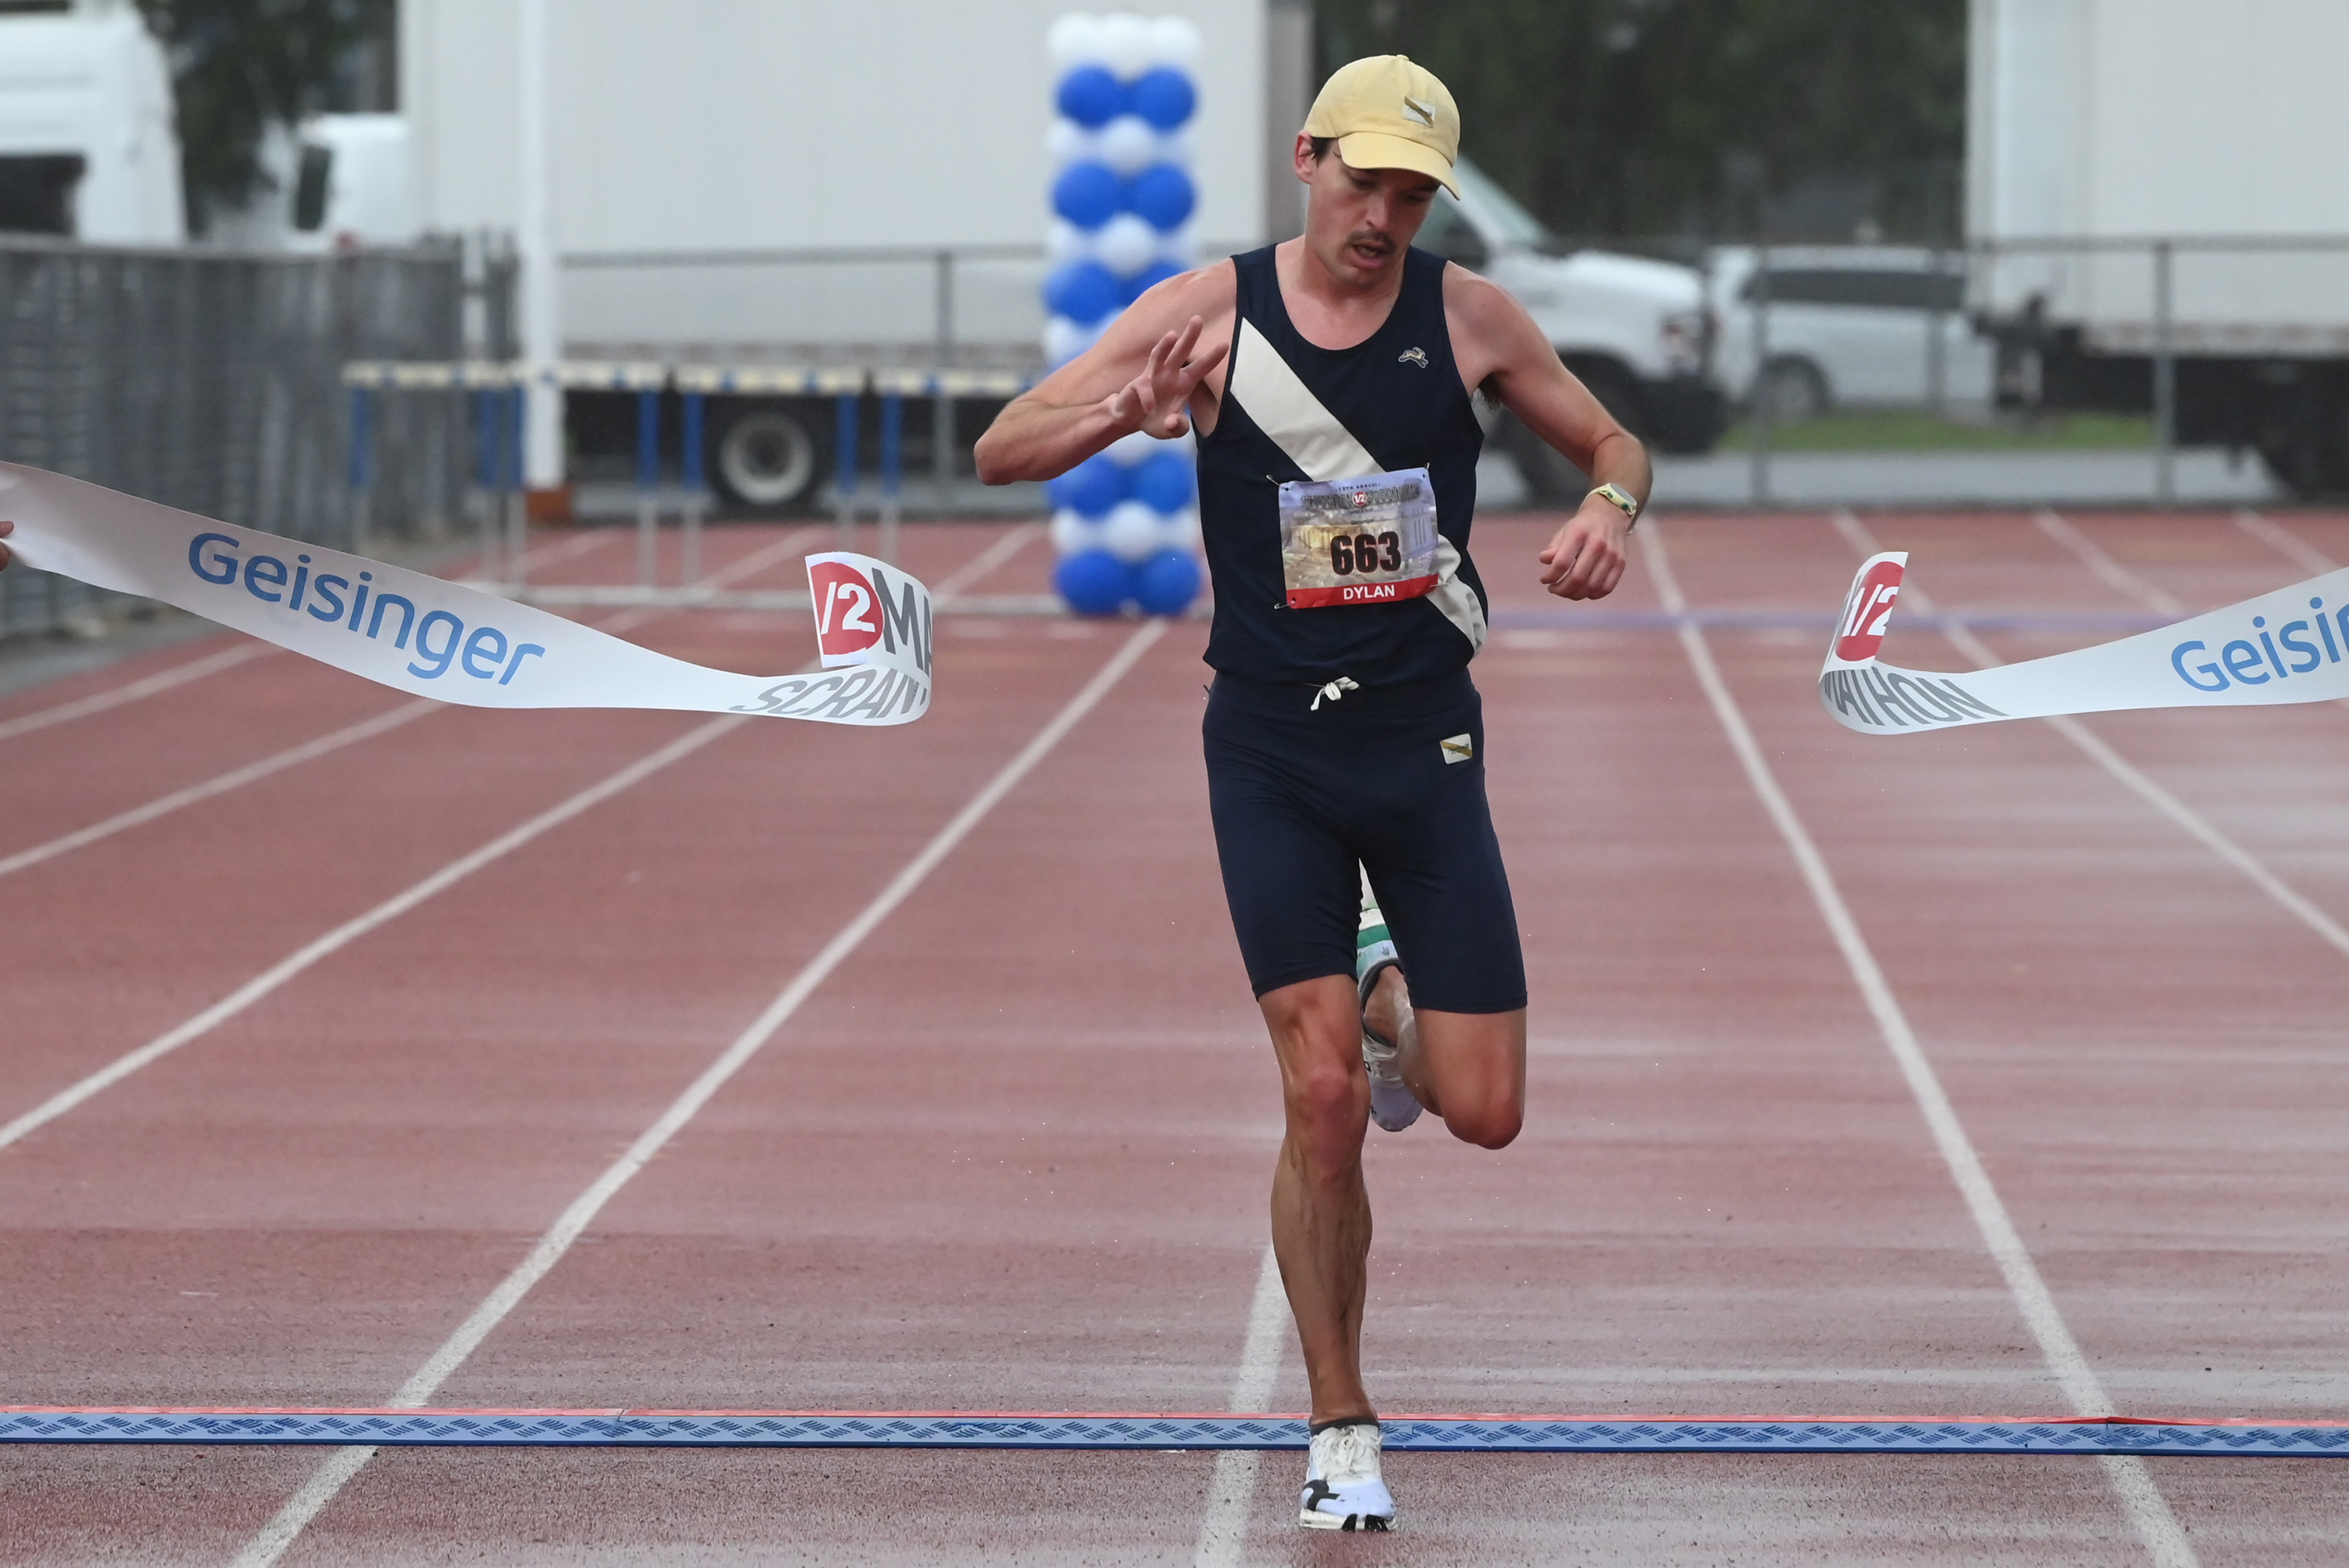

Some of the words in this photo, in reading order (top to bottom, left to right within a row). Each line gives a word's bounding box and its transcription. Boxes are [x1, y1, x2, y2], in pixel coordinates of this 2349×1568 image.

[1354, 492, 1366, 503] 1/2
[1330, 531, 1402, 575] 663
[188, 532, 546, 686] Geisinger
[1344, 585, 1395, 600] DYLAN
[729, 669, 929, 718] SCRAN
